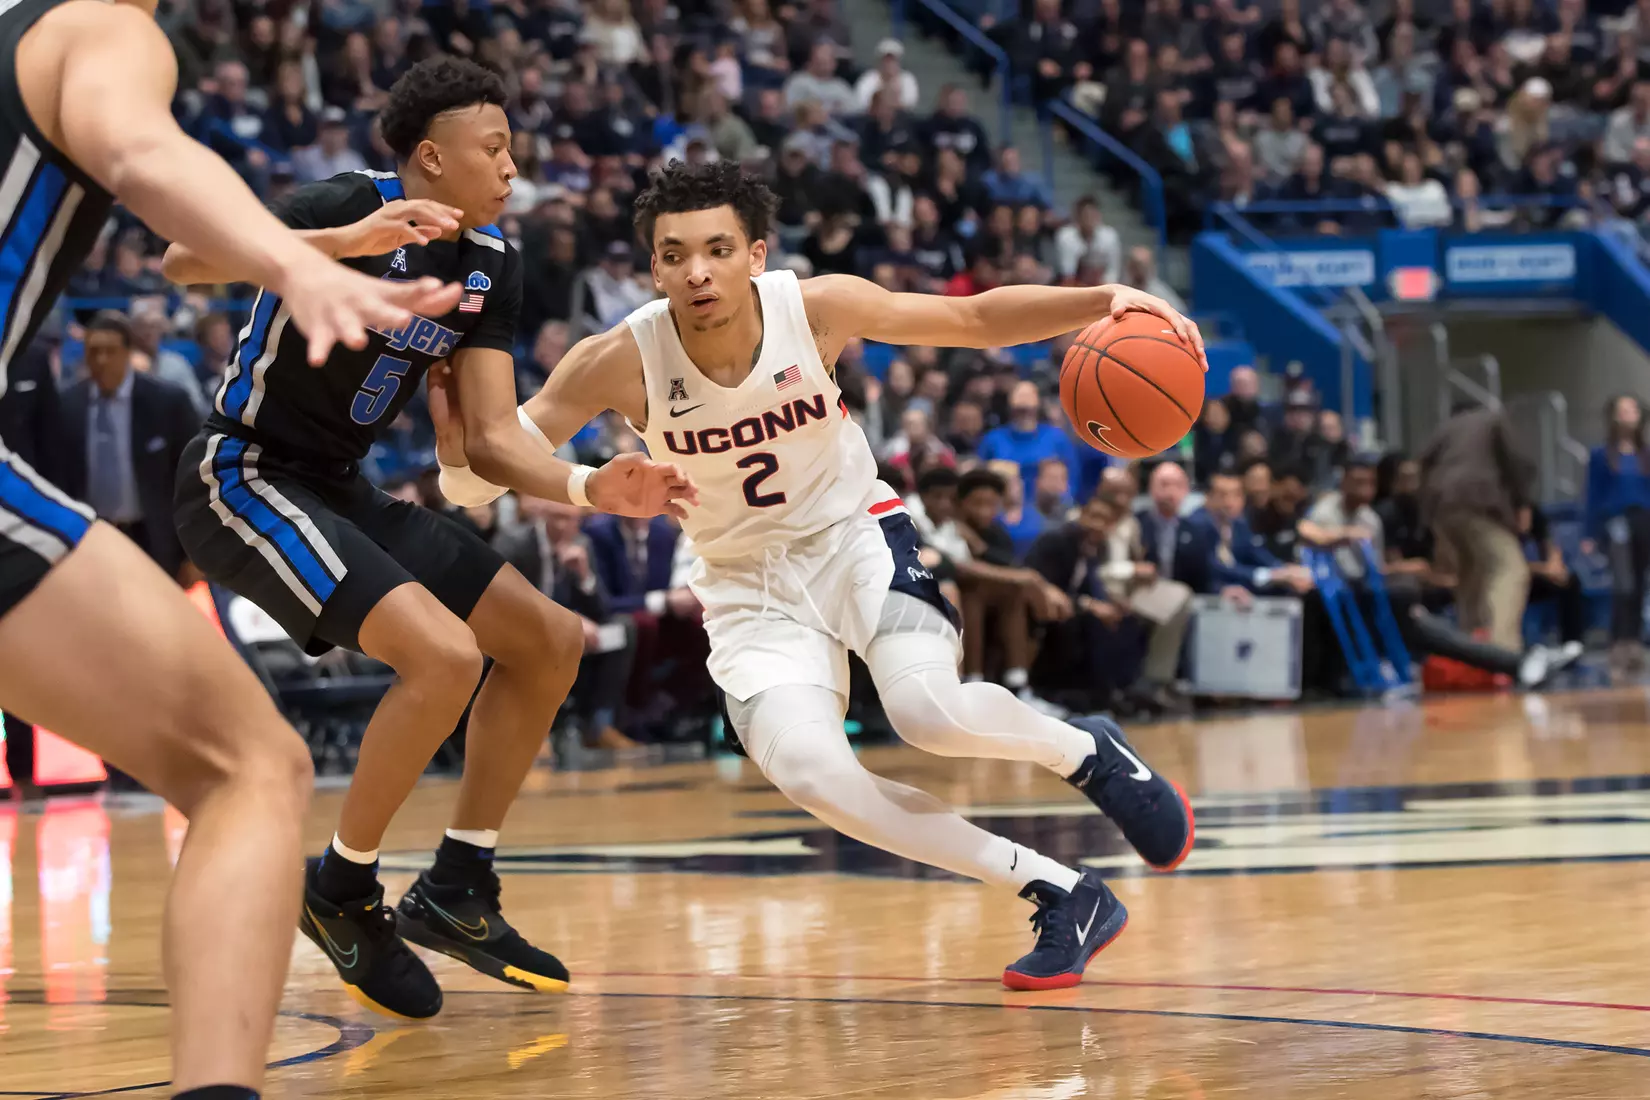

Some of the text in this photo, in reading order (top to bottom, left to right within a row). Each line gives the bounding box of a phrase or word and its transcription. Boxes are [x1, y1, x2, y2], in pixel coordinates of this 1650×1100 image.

[365, 312, 464, 357] gers
[350, 354, 412, 425] 5
[663, 393, 827, 455] UCONN
[736, 452, 787, 507] 2
